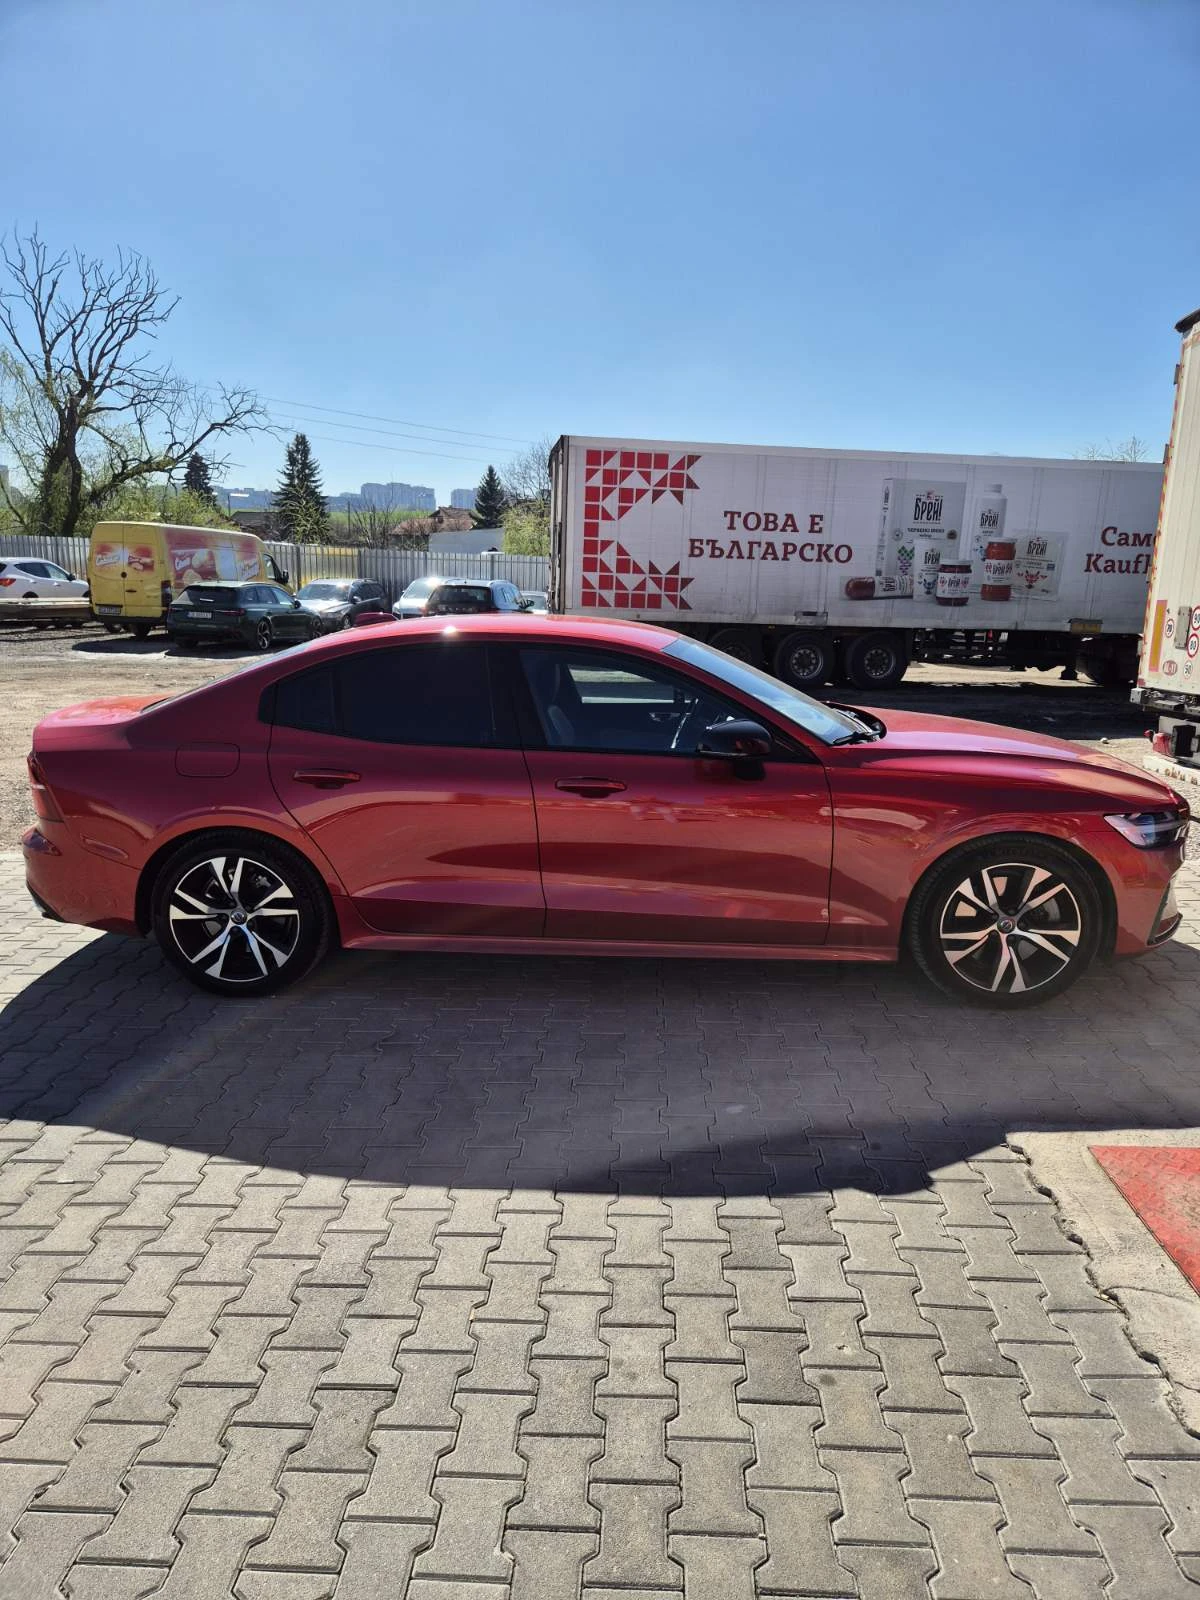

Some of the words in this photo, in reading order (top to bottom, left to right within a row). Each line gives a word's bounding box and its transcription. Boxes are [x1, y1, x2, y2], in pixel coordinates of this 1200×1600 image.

[723, 510, 800, 533] ТОВА
[808, 514, 824, 534] Е
[687, 538, 853, 564] БЪЛГАРСКО
